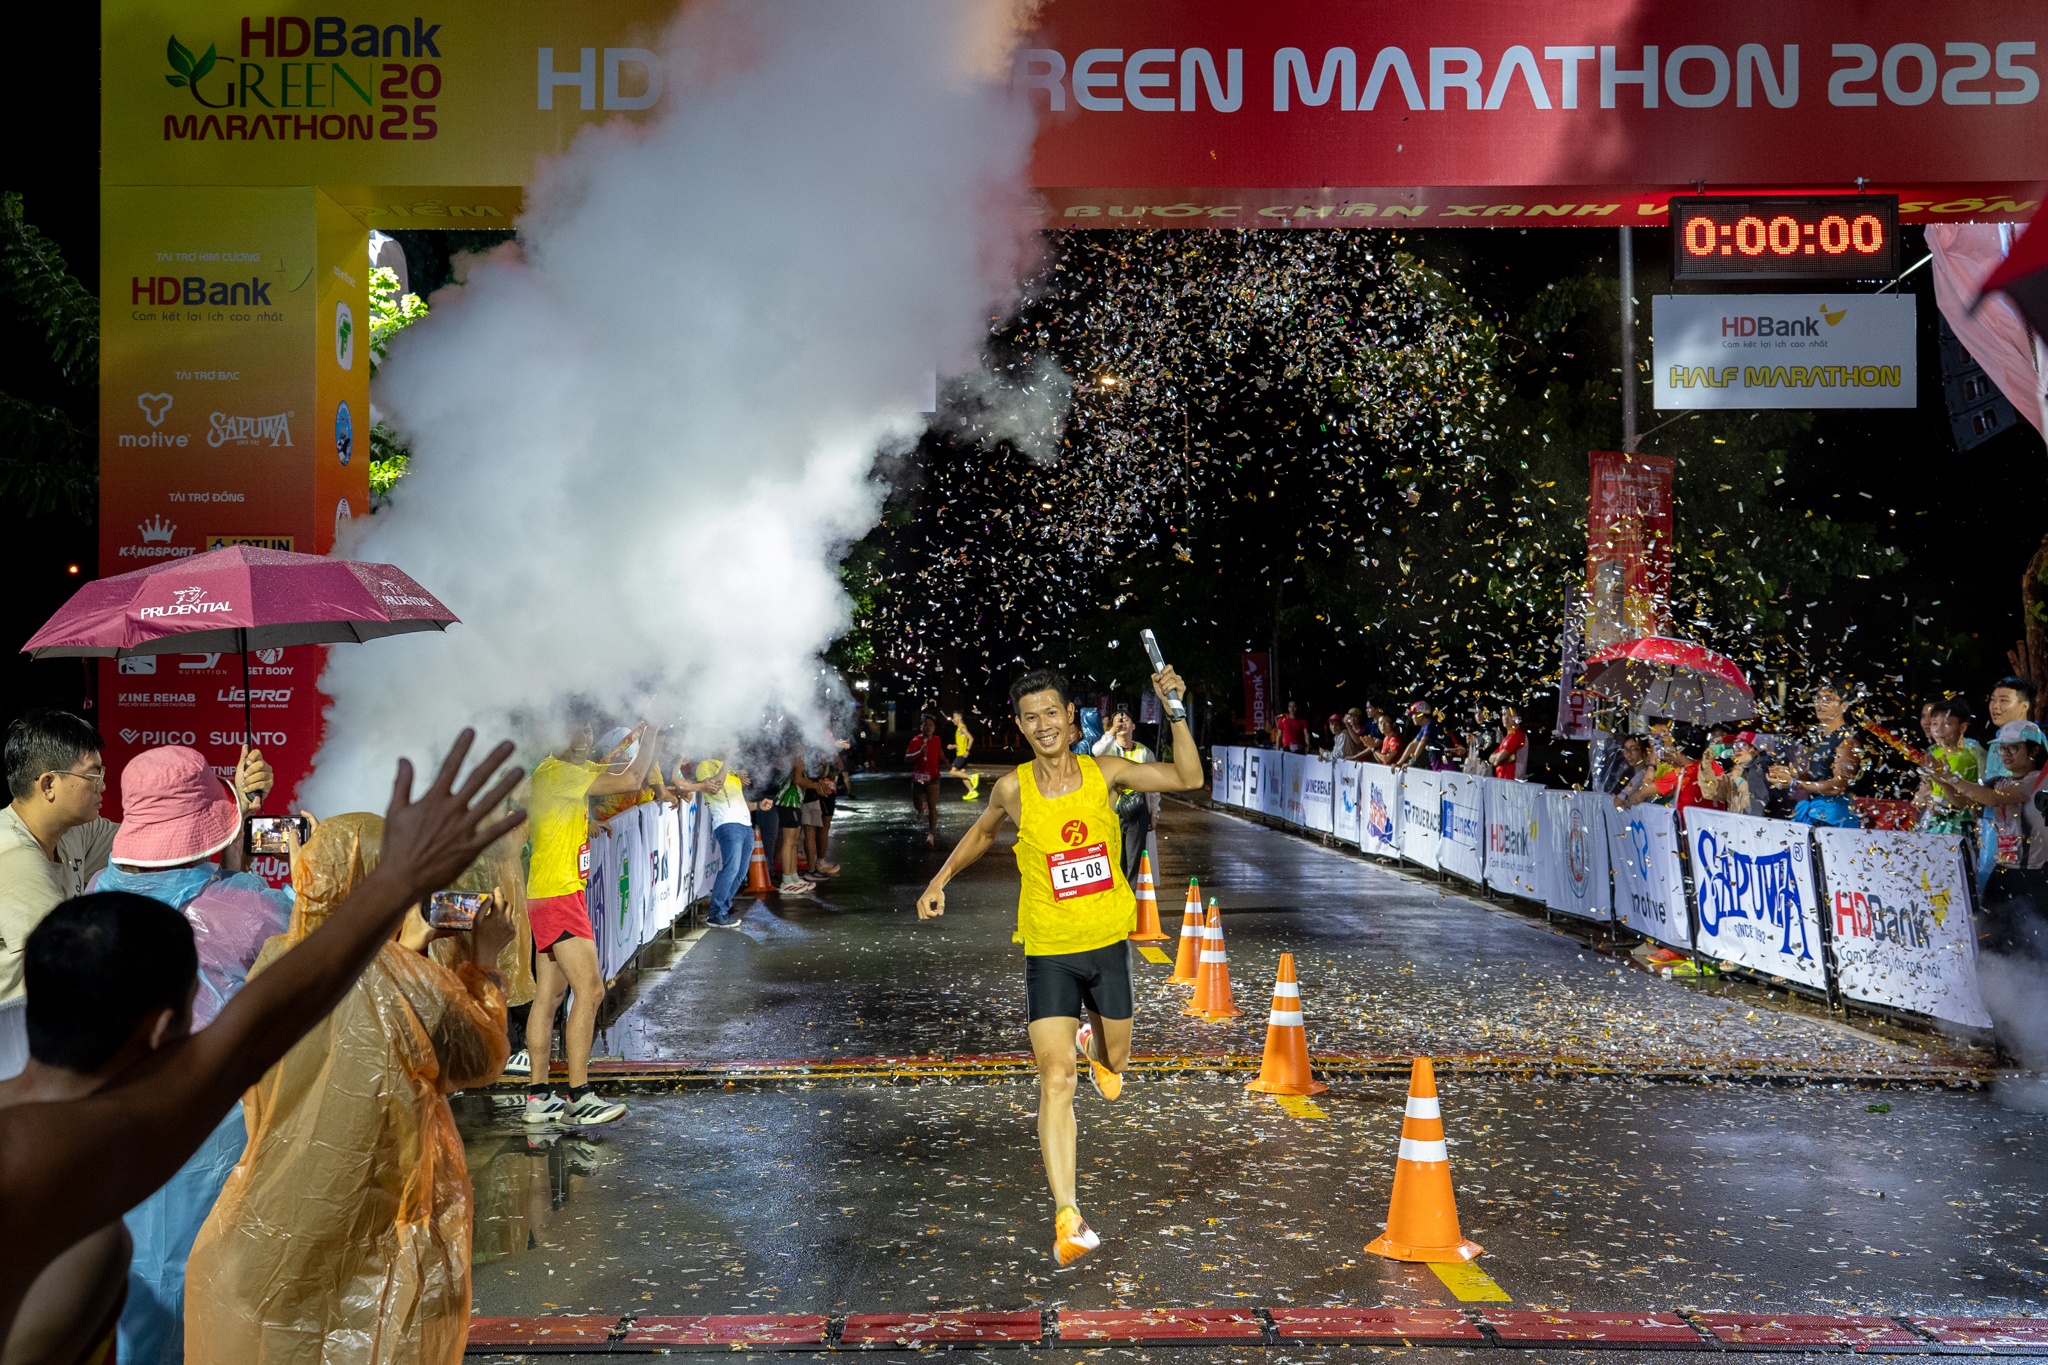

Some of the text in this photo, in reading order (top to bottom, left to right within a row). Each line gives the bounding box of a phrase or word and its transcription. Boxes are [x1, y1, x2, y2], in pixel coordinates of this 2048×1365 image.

[240, 16, 442, 58] HDBank
[190, 56, 442, 109] GREEN 20
[1011, 48, 1243, 112] REEN
[1272, 45, 1801, 112] MARATHON
[1828, 41, 2041, 107] 2025
[164, 104, 439, 141] MARATHON 25
[1438, 204, 1623, 218] XANH
[1636, 204, 1669, 217] V
[1898, 195, 2040, 214] SỐN
[1685, 214, 1884, 256] 0:00:00
[131, 276, 272, 306] HDBank
[132, 311, 156, 322] Cam
[162, 311, 181, 322] kết
[229, 313, 251, 322] cao
[1721, 316, 1820, 337] HDBank
[1722, 340, 1740, 349] Cam
[1669, 365, 1901, 389] HALF MARATHON
[118, 431, 189, 447] motive
[206, 411, 295, 448] SAPUWA
[140, 601, 233, 620] PRUDENTIAL
[265, 666, 294, 675] BODY
[118, 693, 196, 702] KINE REHAB
[1252, 674, 1265, 731] HDBank
[142, 731, 197, 745] PJICO
[209, 731, 287, 746] SUUNTO
[1061, 861, 1102, 884] E4-08
[1697, 829, 1815, 961] SAPUWA
[1835, 890, 1932, 950] HDBank
